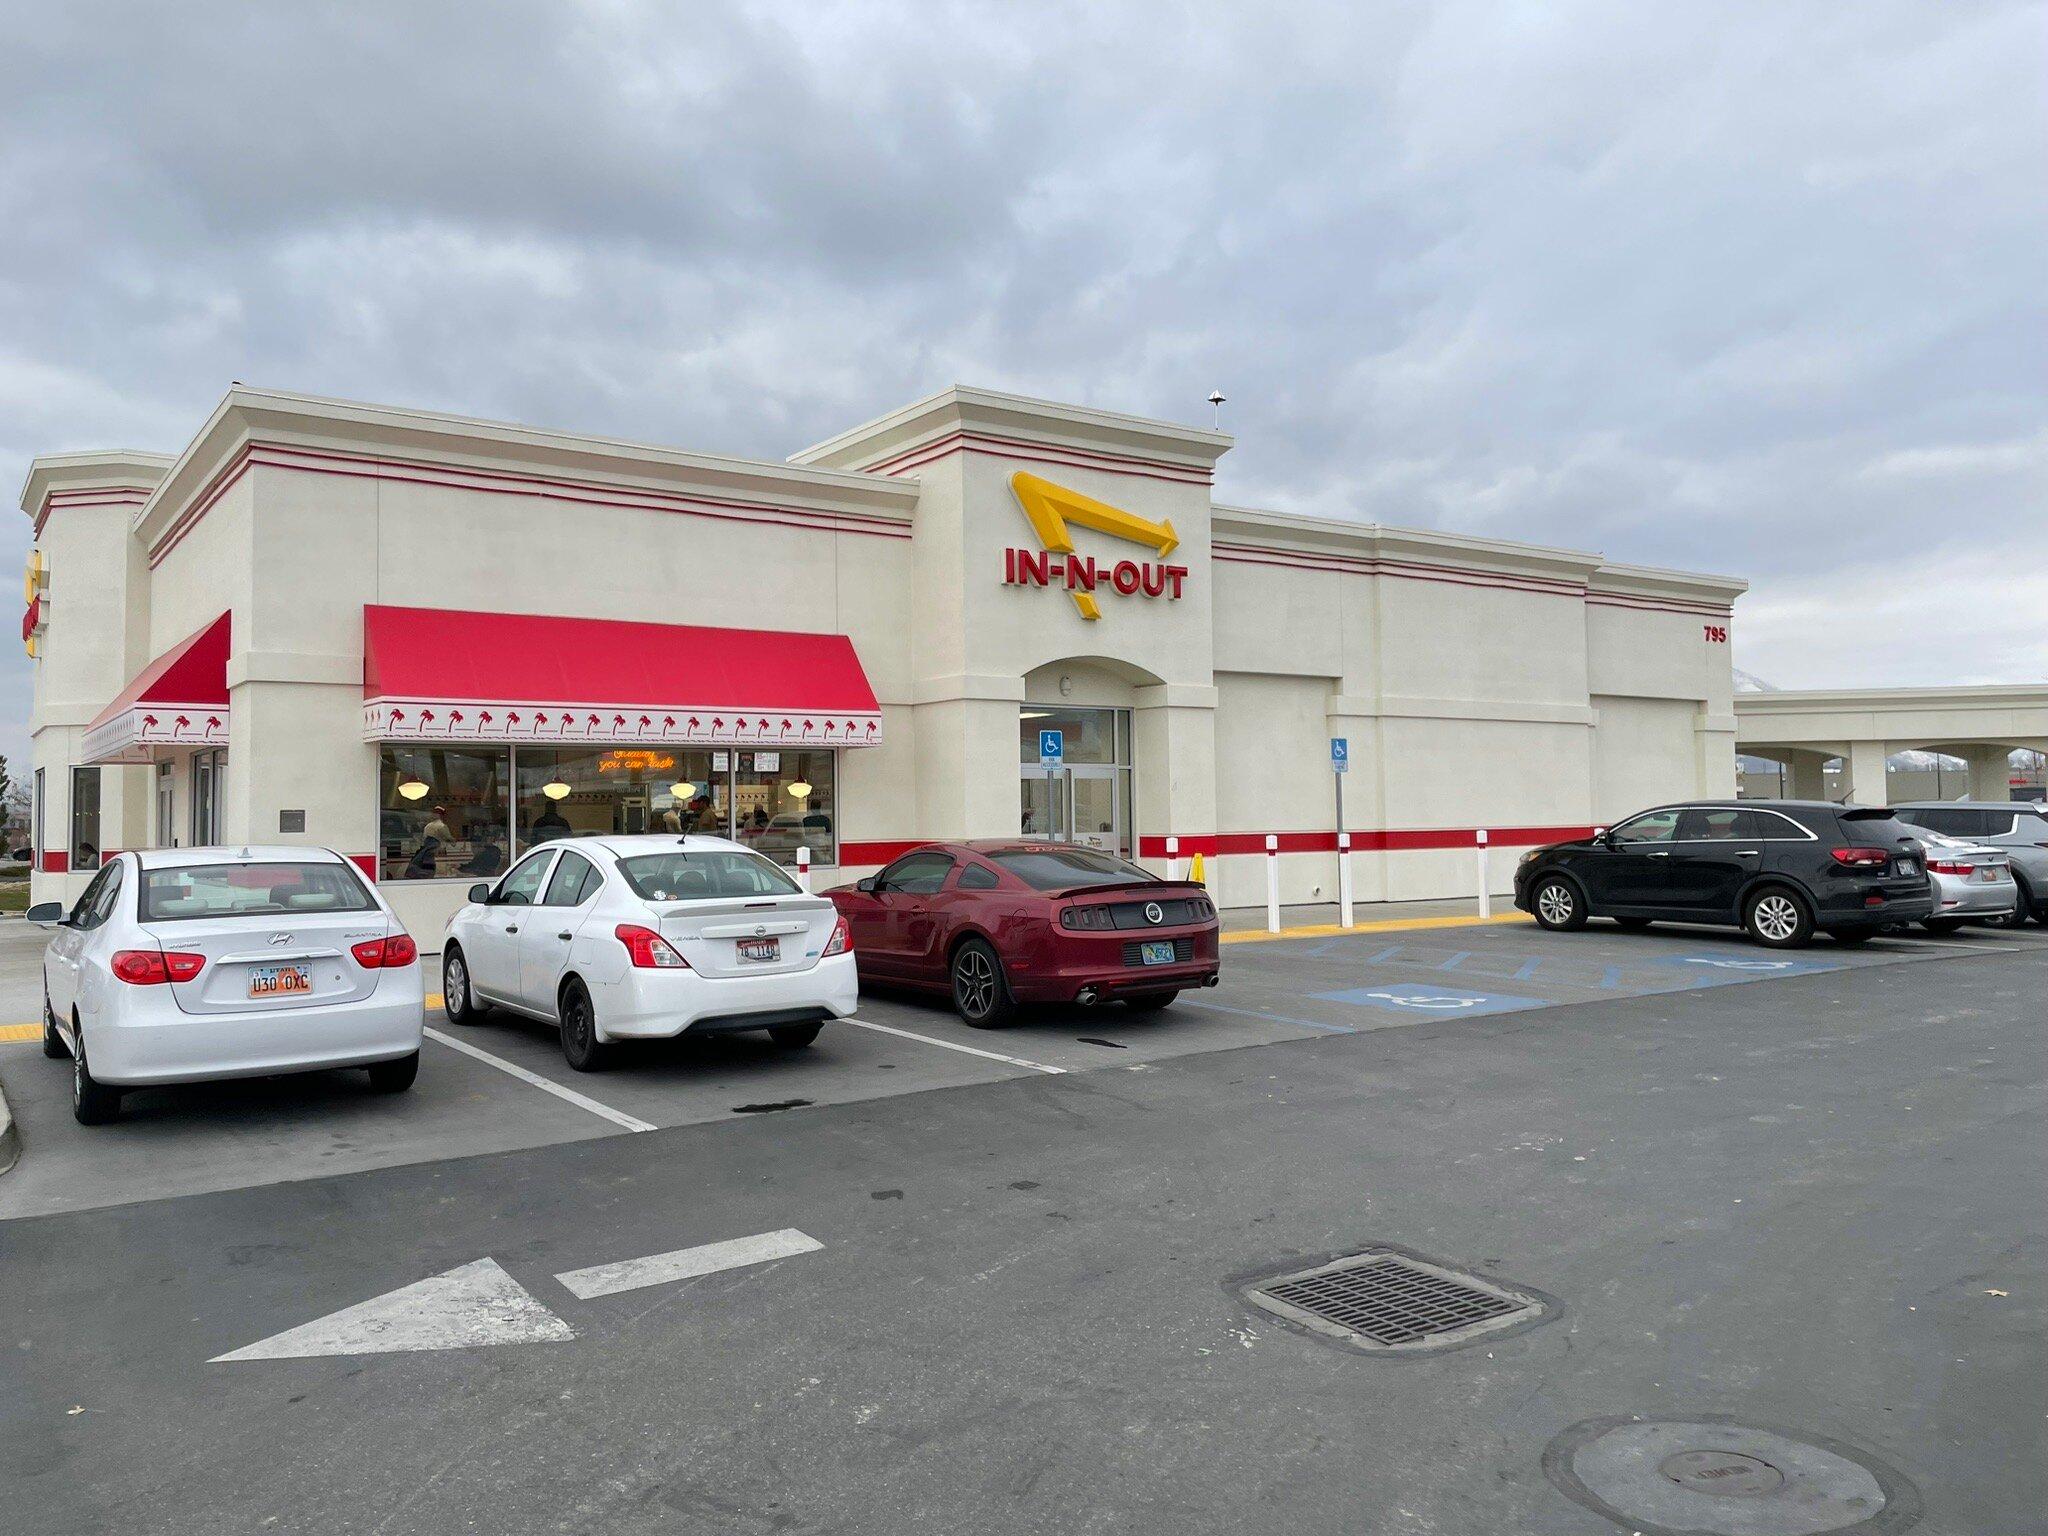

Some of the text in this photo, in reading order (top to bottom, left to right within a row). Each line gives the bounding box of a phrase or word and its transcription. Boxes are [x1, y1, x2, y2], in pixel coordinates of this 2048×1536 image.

[1003, 547, 1189, 600] IN-N-OUT
[1703, 625, 1727, 643] 795
[598, 760, 621, 773] you
[624, 760, 644, 769] can
